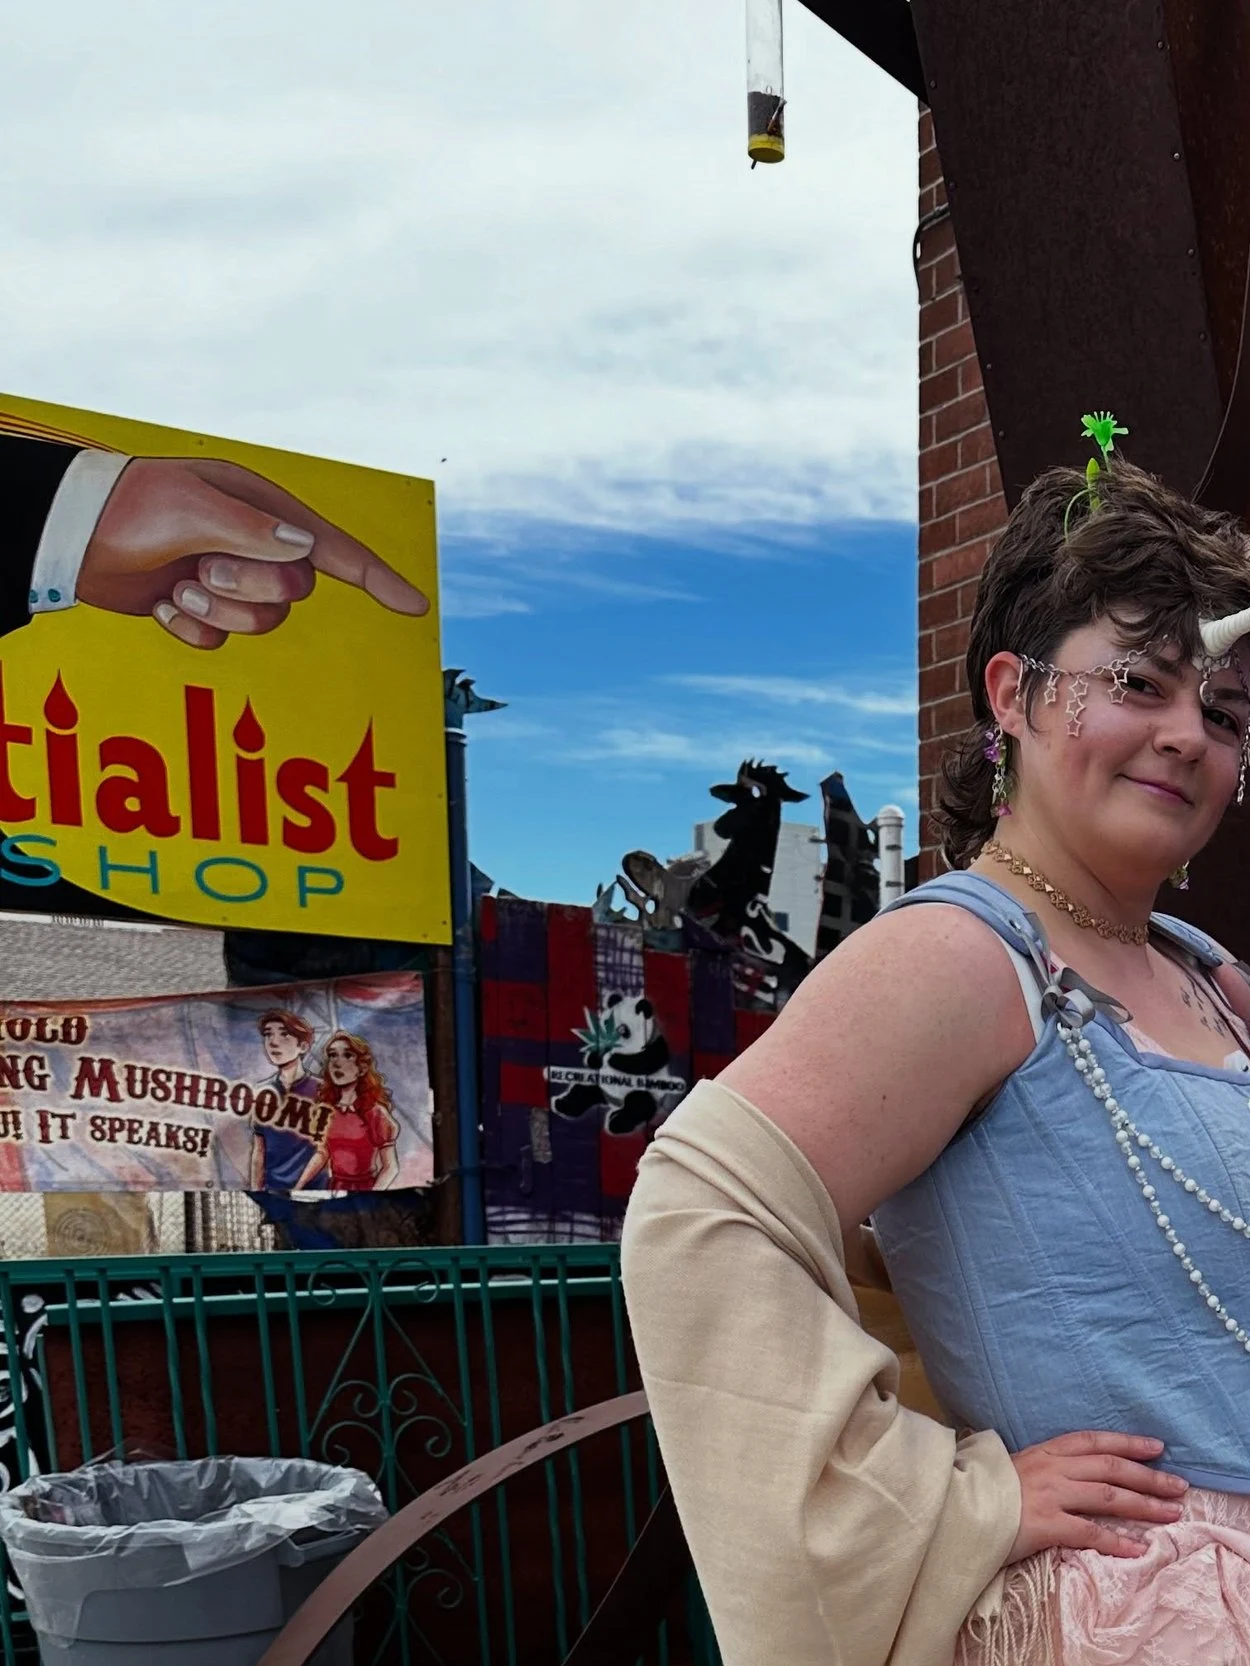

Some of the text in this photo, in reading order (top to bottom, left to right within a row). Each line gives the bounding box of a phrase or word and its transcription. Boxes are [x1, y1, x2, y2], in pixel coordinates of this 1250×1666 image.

[0, 833, 344, 909] SHOP
[0, 1016, 88, 1045] OLD
[89, 1115, 212, 1158] SPEAKS!
